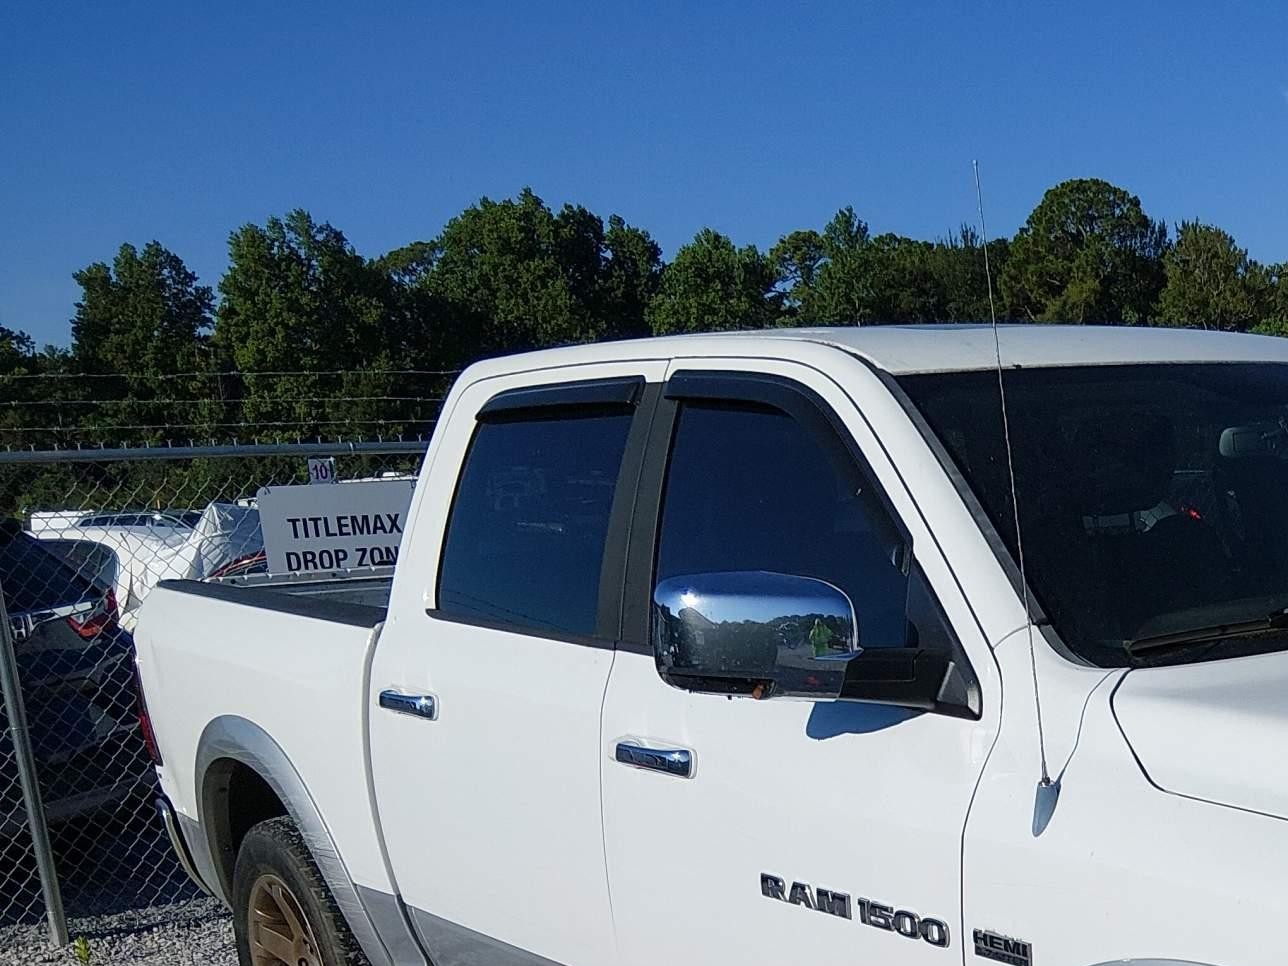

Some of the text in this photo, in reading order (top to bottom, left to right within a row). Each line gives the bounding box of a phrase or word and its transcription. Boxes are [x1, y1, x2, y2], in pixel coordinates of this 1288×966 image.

[312, 464, 328, 480] 10
[286, 513, 403, 539] TITLEMAX
[286, 549, 348, 571] DROP
[760, 872, 951, 949] RAM 1500
[973, 928, 1030, 959] HEMI
